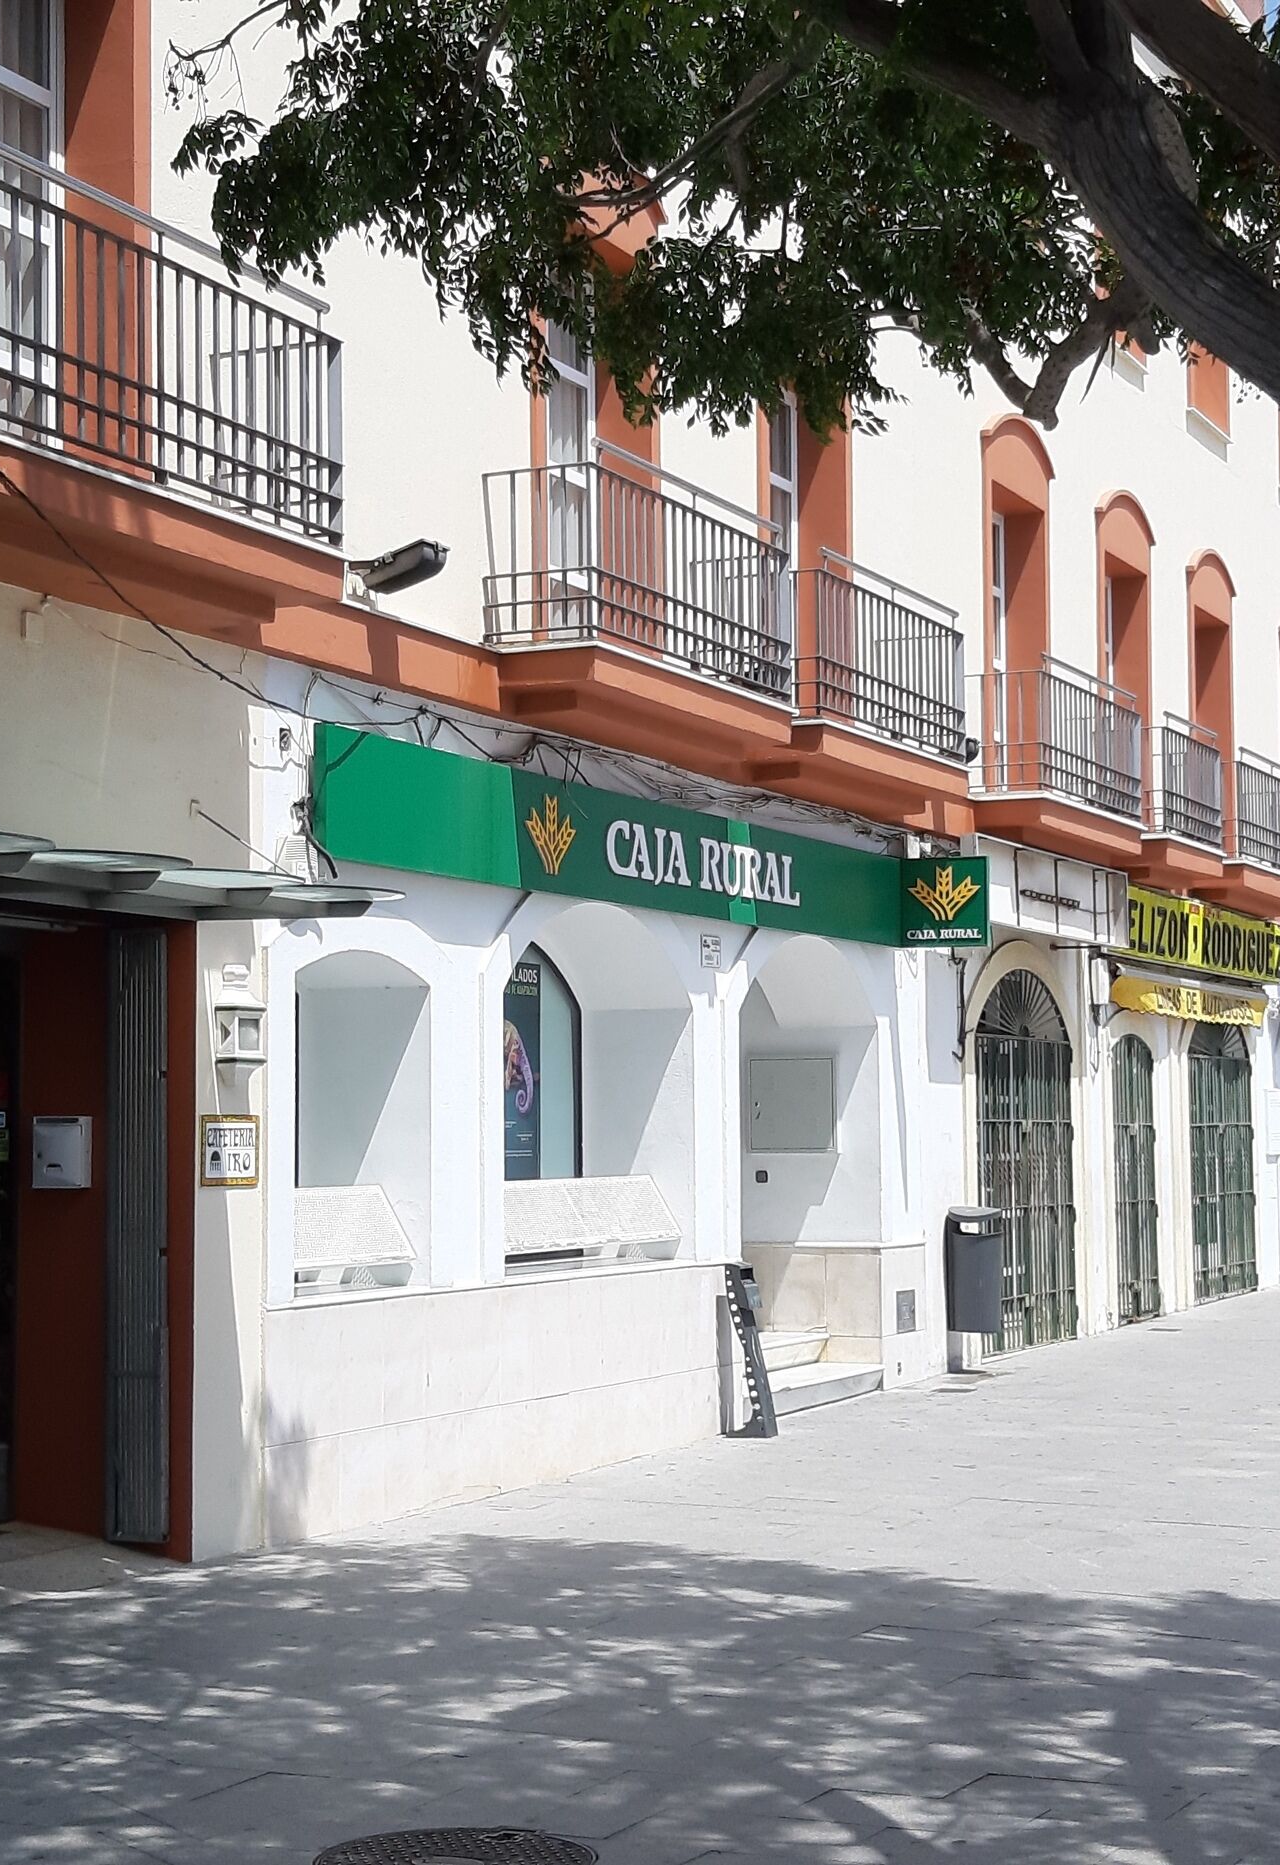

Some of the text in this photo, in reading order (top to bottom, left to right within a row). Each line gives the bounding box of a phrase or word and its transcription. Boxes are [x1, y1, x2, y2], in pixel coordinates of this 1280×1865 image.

[606, 819, 801, 907] CAJA RURAL
[906, 928, 982, 940] CAJA RURAL
[1128, 899, 1190, 960] ELIZON
[1185, 990, 1198, 1015] DE
[206, 1127, 256, 1148] CAFETERIA
[227, 1152, 251, 1174] IRO
